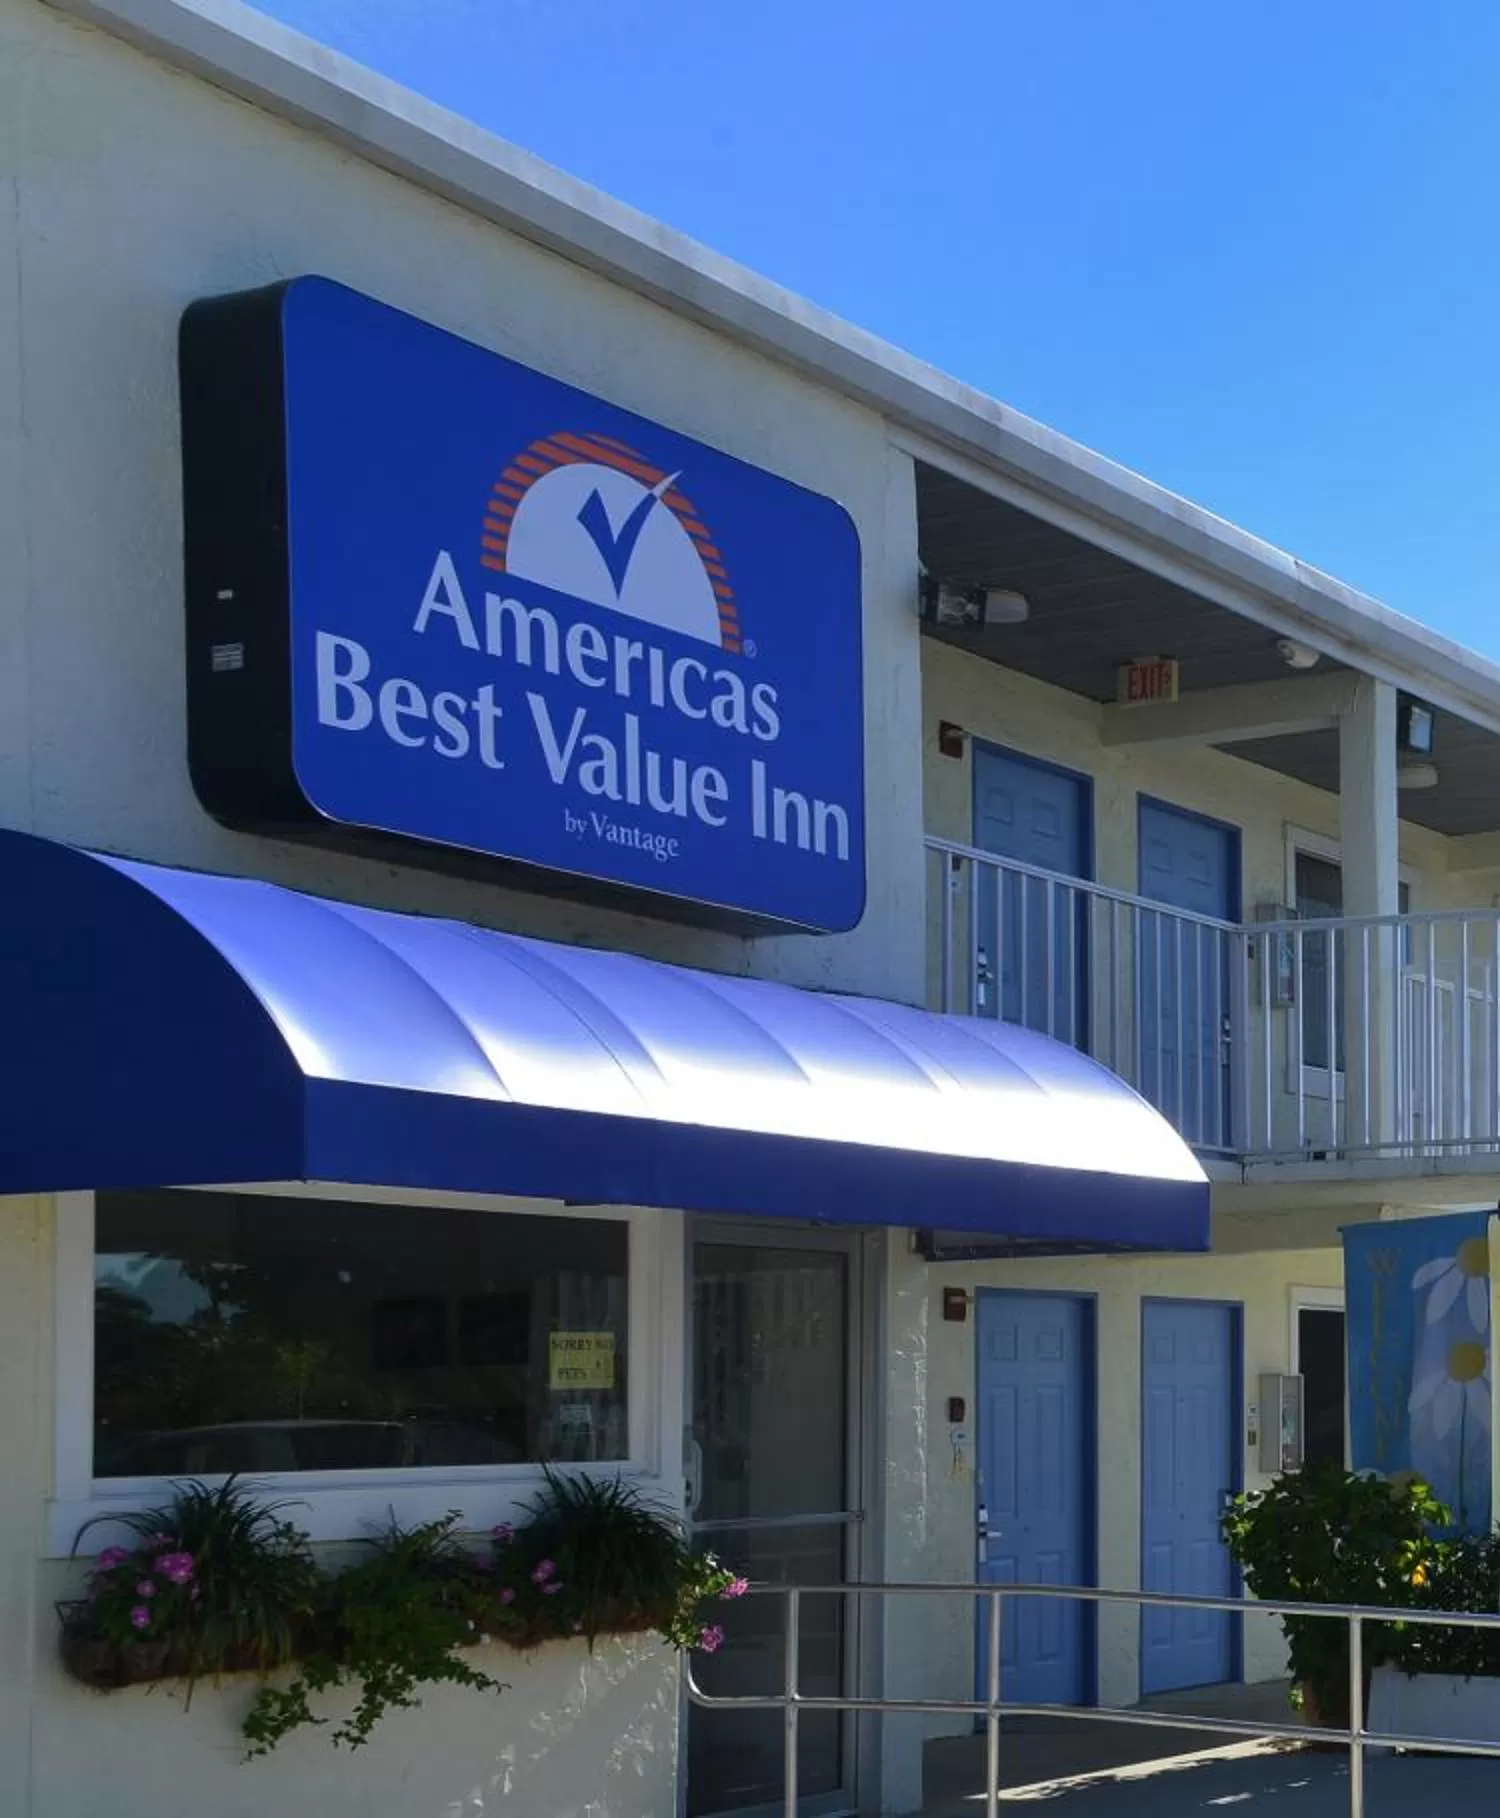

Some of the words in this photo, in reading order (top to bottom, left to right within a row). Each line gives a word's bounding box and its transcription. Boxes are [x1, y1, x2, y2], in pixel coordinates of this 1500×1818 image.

[412, 549, 781, 742] Americas
[1127, 663, 1167, 701] EXIT
[315, 630, 505, 770] Best
[526, 692, 729, 828] Value
[752, 759, 850, 861] Inn
[563, 807, 588, 841] by
[589, 810, 680, 863] Vantage
